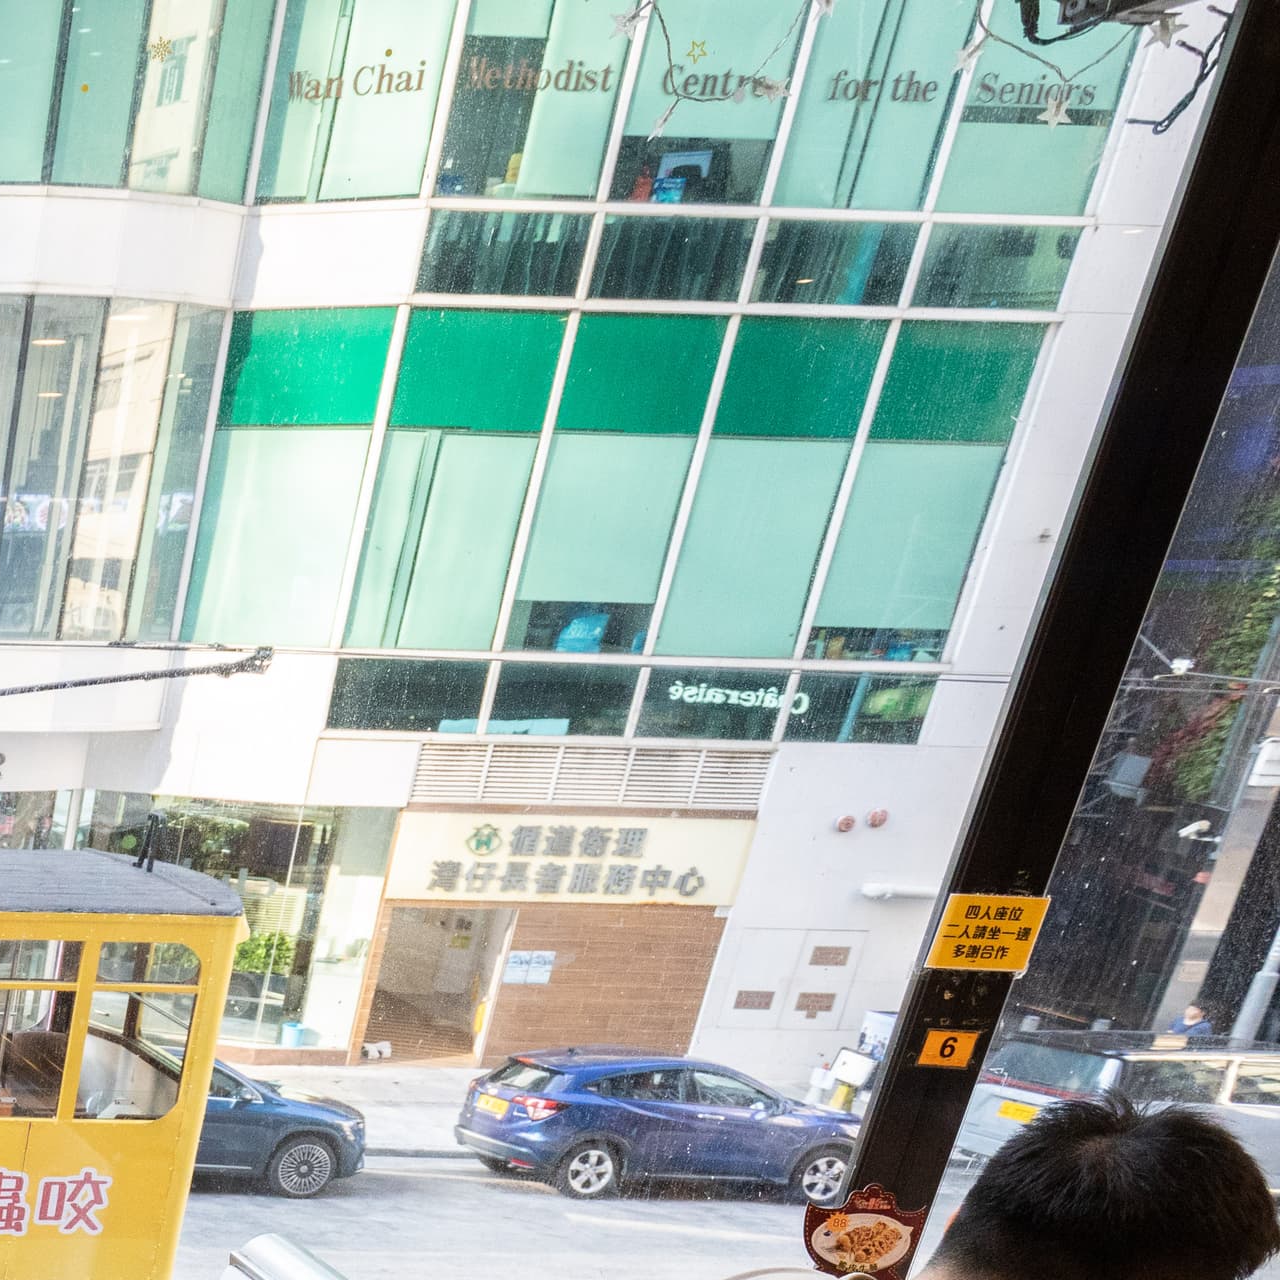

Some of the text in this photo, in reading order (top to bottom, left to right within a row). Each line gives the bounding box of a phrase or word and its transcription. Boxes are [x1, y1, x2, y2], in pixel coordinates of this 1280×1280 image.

[289, 69, 343, 103] Wan
[353, 60, 427, 97] Chai
[467, 56, 615, 93] Methodist
[828, 70, 879, 102] for
[891, 71, 938, 102] the
[976, 71, 1097, 106] Seniors
[426, 860, 705, 897] 灣仔長者服務中心
[965, 905, 1024, 921] 四人座位
[943, 924, 1032, 941] 二人請坐一邊
[952, 945, 1009, 960] 多謝合作
[940, 1037, 958, 1058] 6
[832, 1217, 848, 1229] 88
